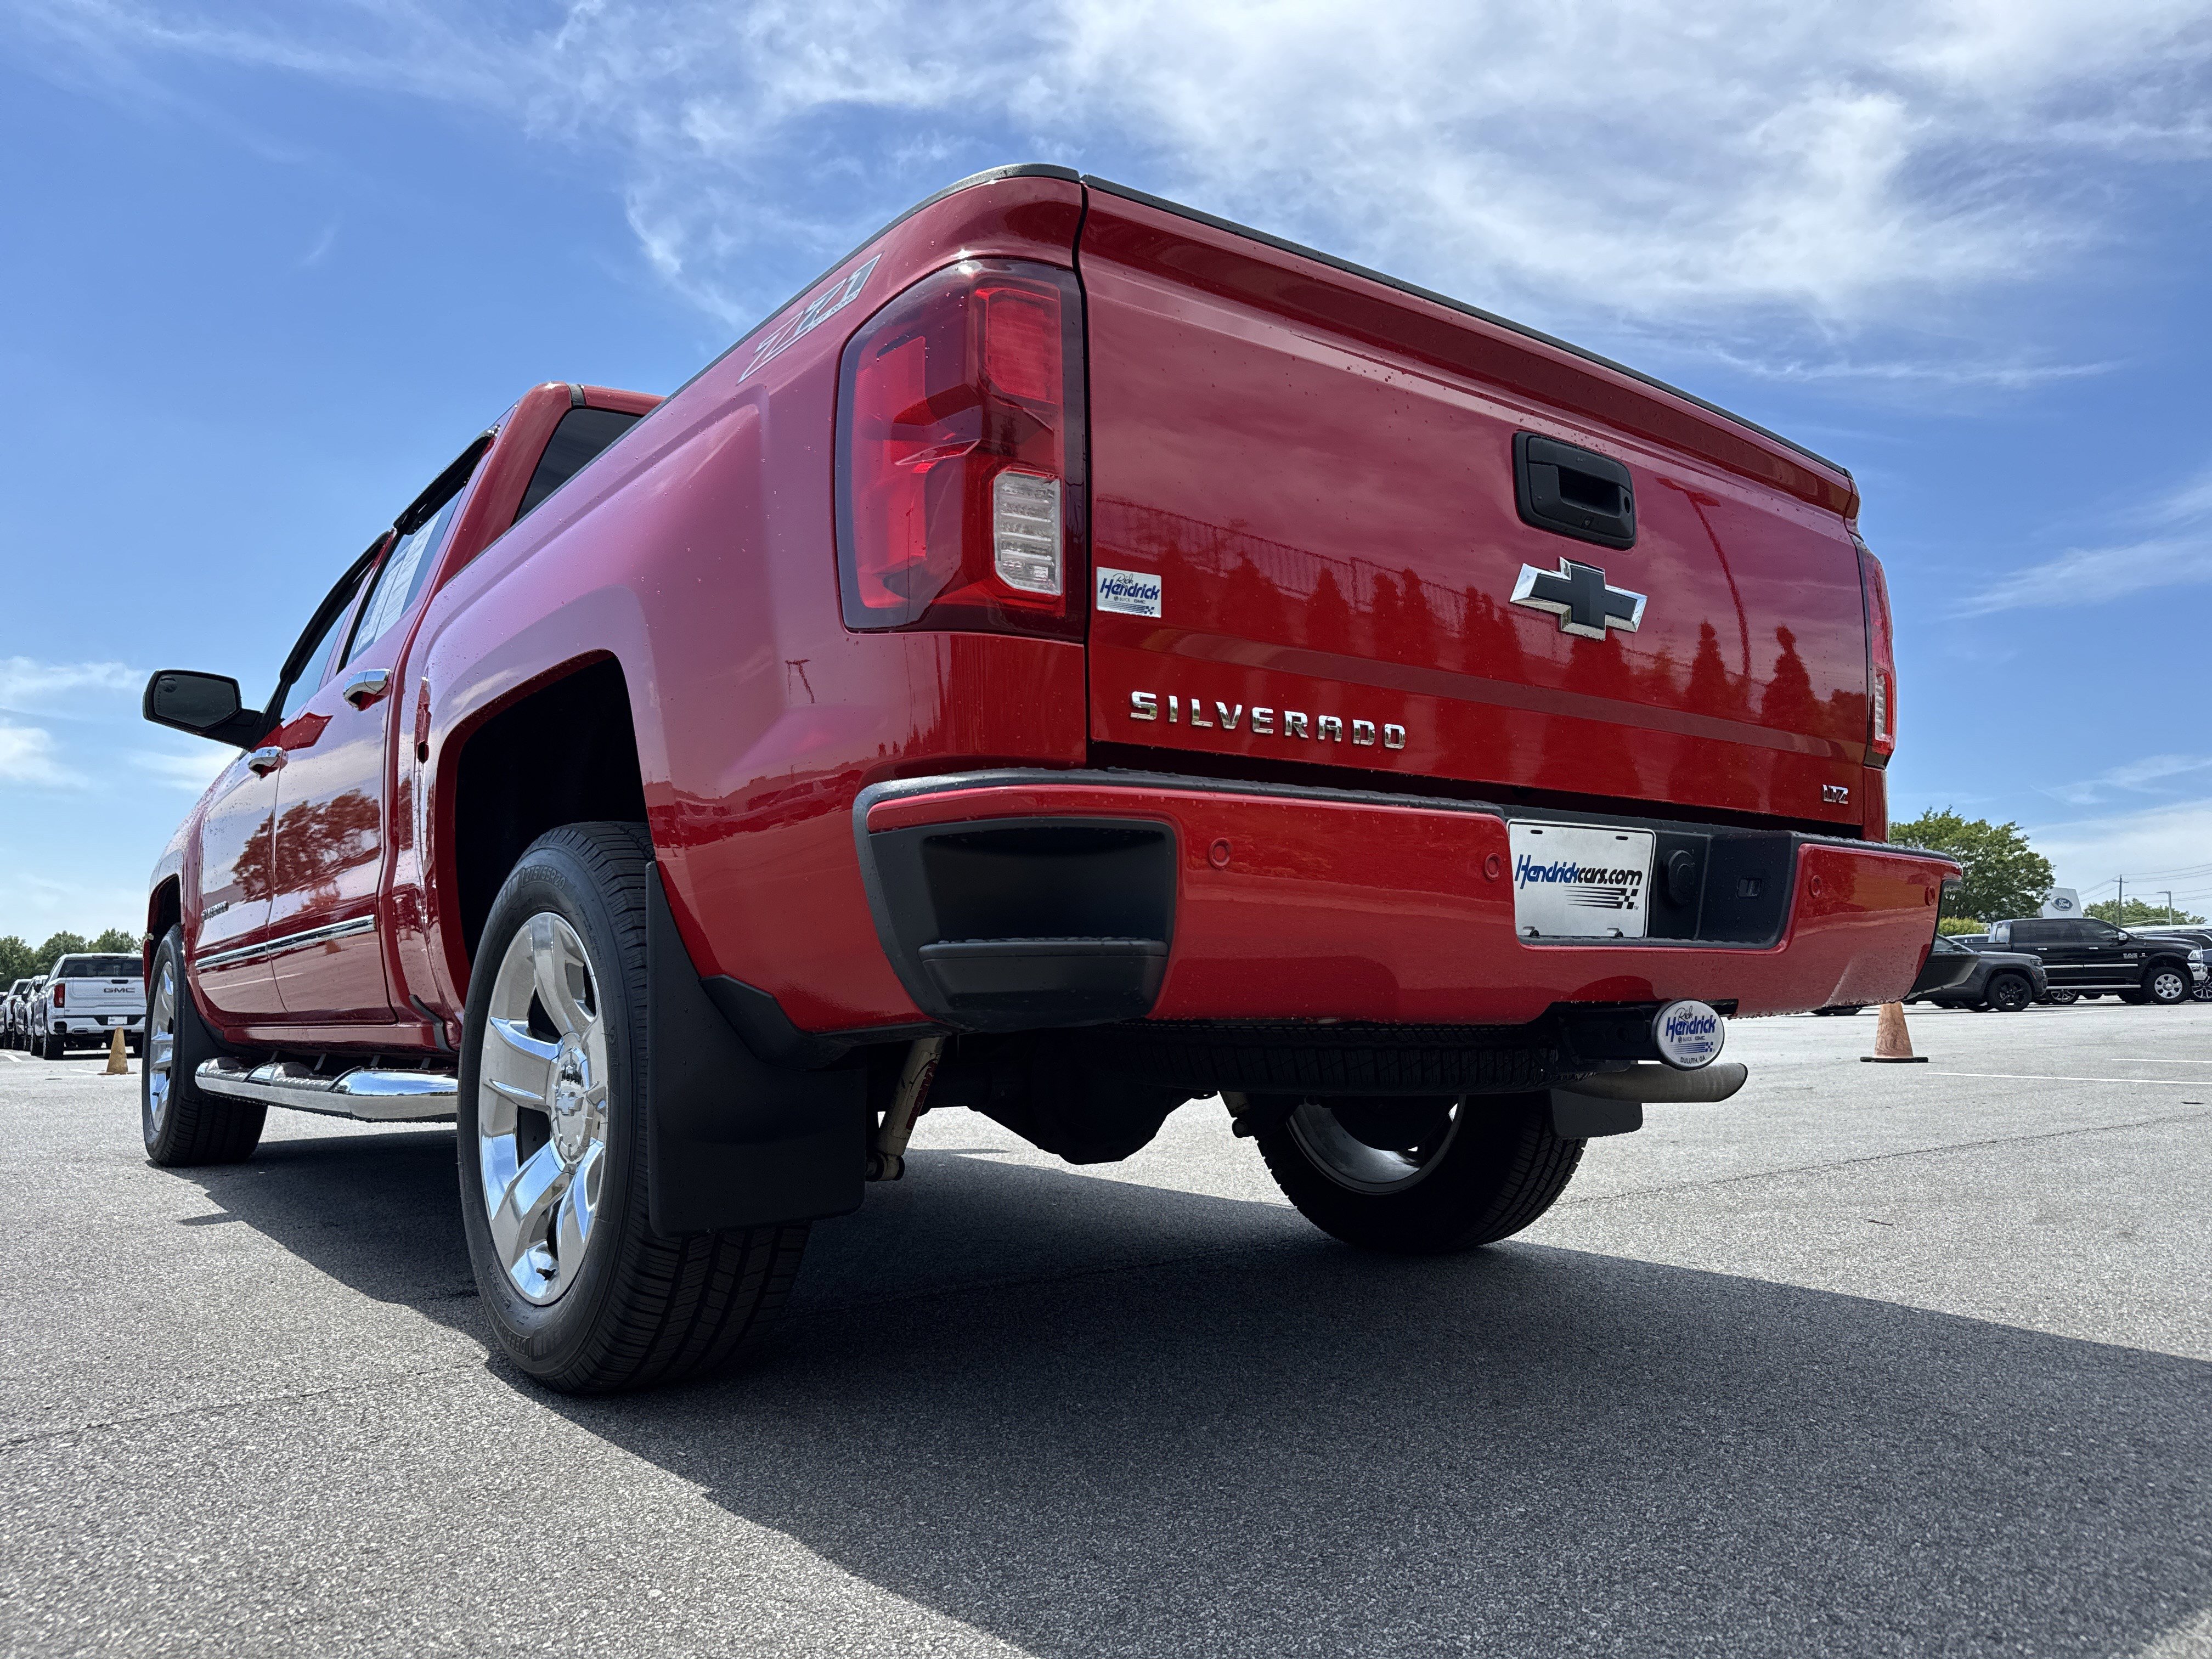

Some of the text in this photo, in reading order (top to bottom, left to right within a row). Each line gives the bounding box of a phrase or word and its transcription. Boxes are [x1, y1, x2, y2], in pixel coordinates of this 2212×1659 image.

[736, 251, 885, 386] Z71
[1099, 578, 1161, 600] Hendrick
[1113, 573, 1134, 588] Rick
[1130, 691, 1406, 749] SILVERADO
[1822, 784, 1849, 804] LTZ
[1514, 854, 1643, 890] Hendrickcars.com
[2058, 899, 2070, 907] Ford
[1675, 1005, 1694, 1024] Rick
[1666, 1015, 1717, 1042] Hendrick
